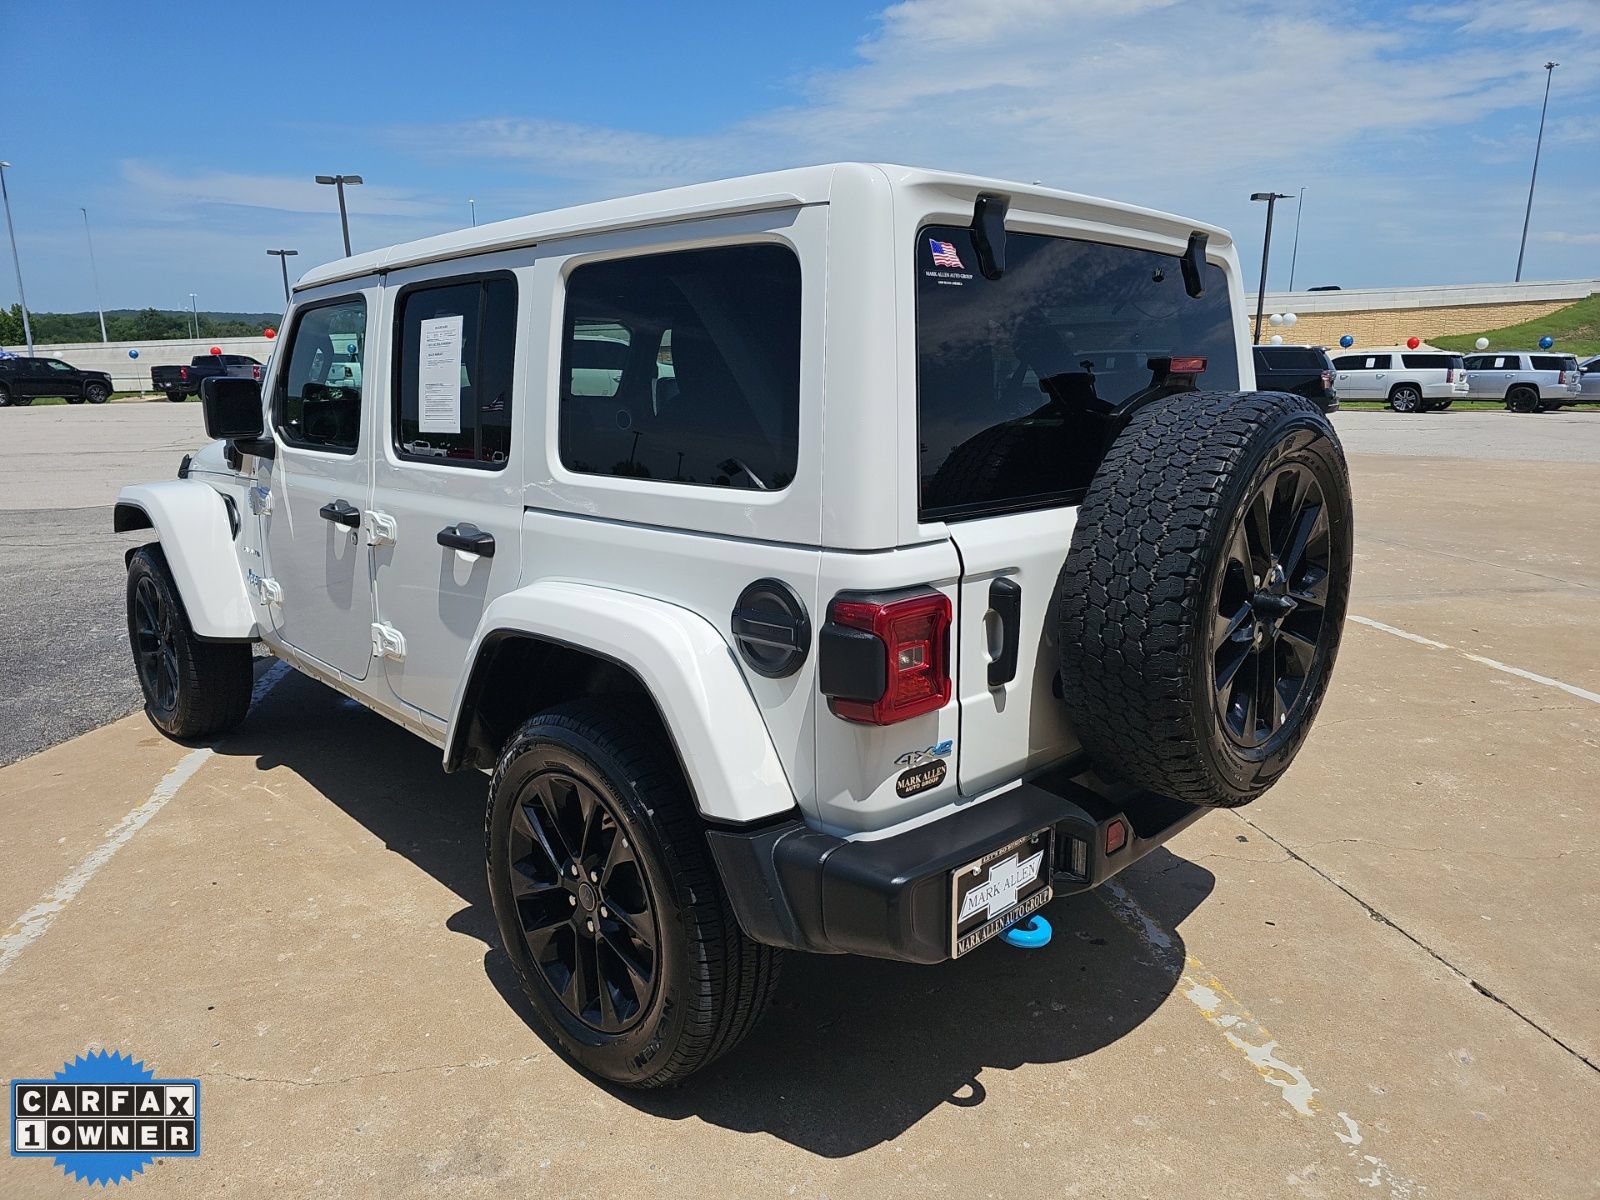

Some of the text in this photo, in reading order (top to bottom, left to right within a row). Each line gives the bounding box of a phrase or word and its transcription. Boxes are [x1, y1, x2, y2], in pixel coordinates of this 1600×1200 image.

[897, 766, 946, 790] MARK ALLEN
[905, 777, 940, 793] AUTO GROUP
[968, 862, 1036, 911] MARK ALLEN
[958, 890, 1050, 955] MARK ALLEN AUTO GROUP
